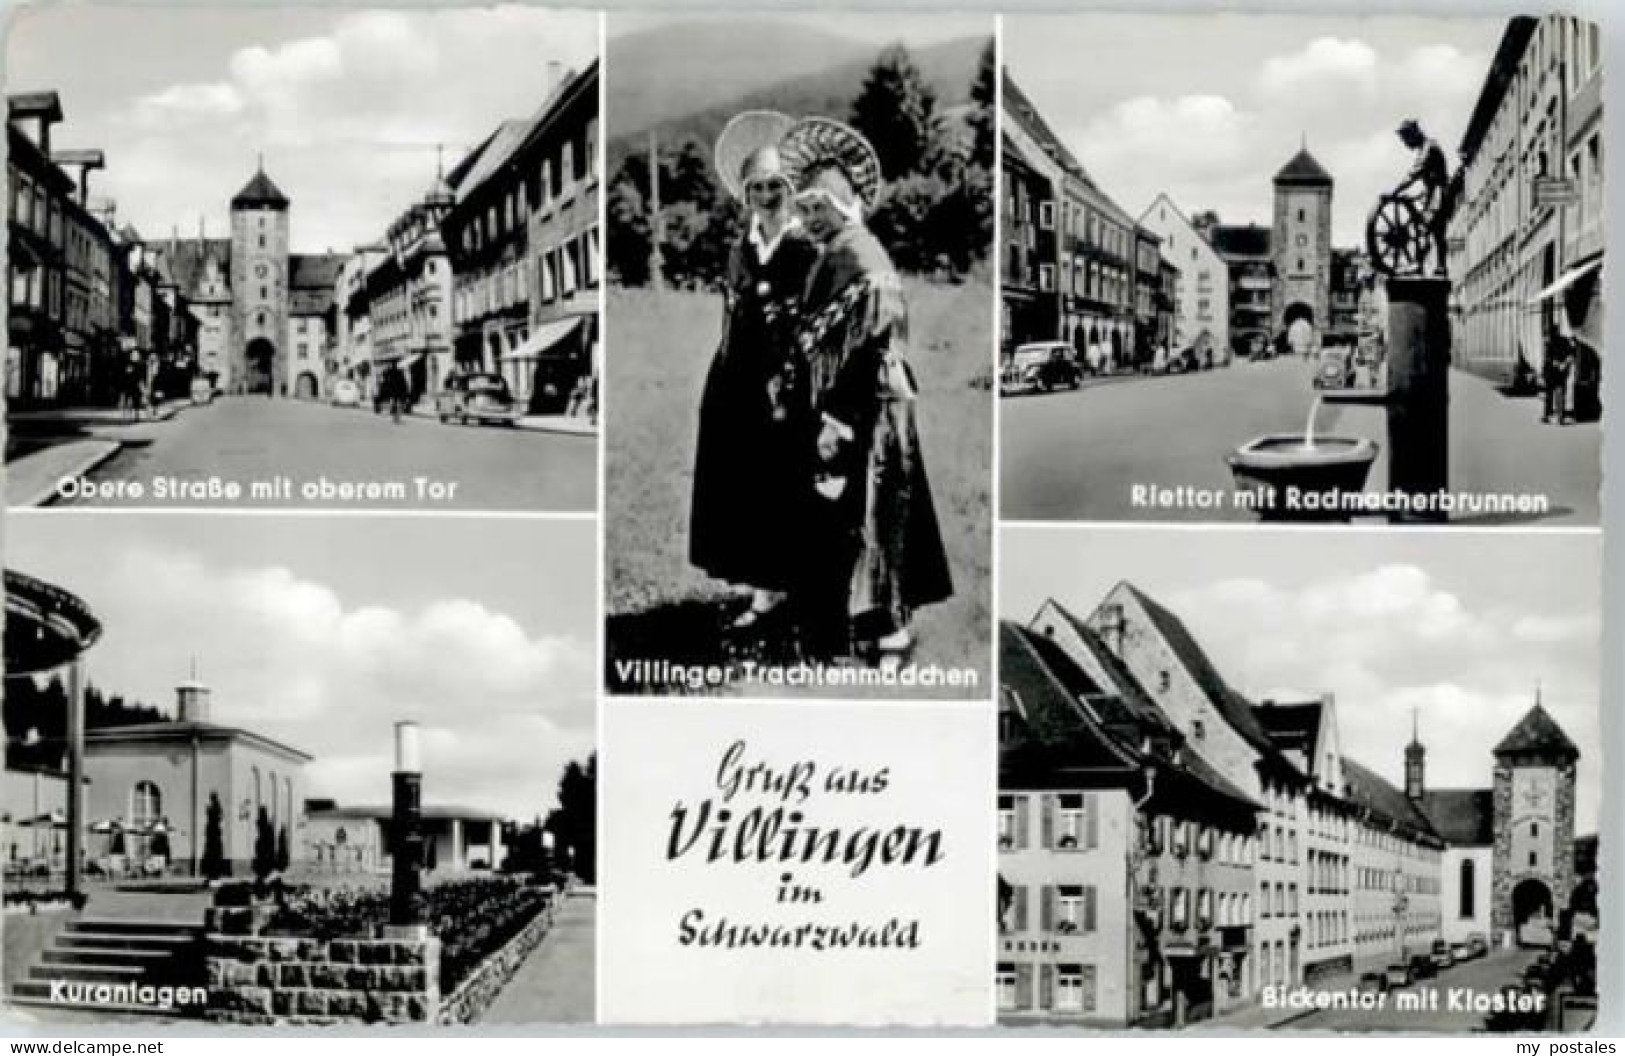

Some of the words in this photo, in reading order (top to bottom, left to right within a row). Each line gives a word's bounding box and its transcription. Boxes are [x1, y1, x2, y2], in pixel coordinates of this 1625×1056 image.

[716, 739, 816, 803] Gruß
[824, 766, 891, 794] aus
[665, 798, 946, 878] Villingen
[776, 872, 823, 904] im
[678, 907, 922, 951] Schwarzwald
